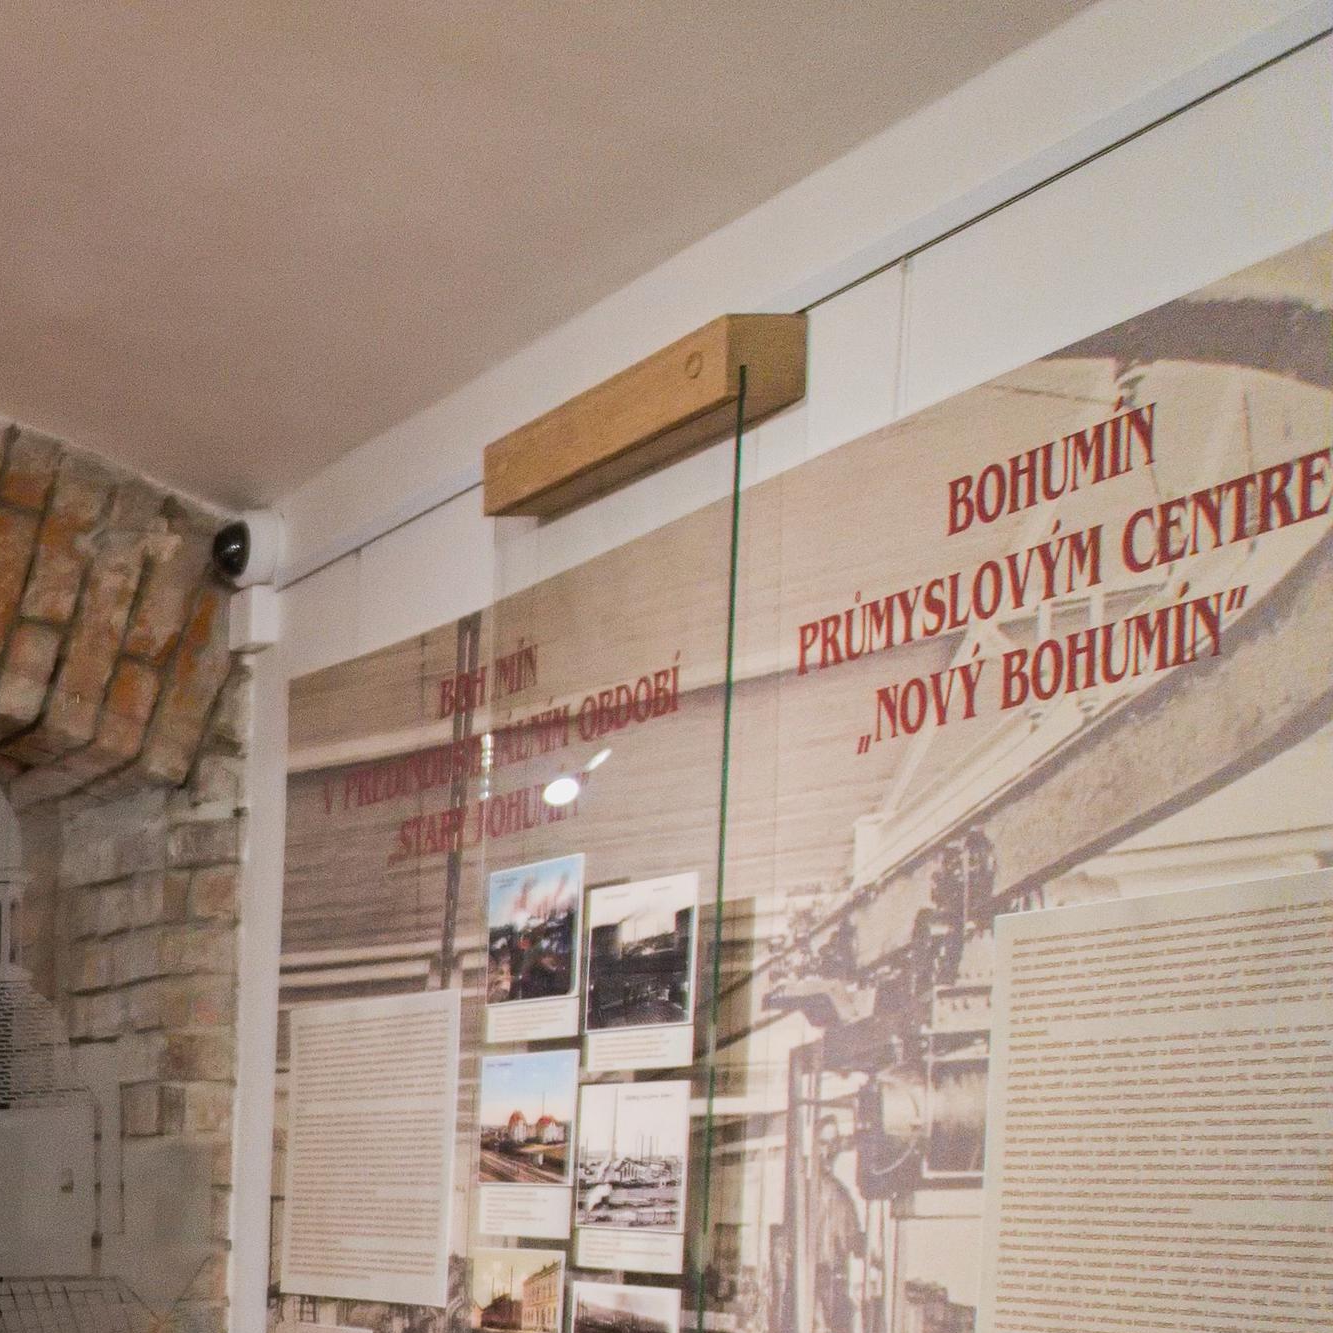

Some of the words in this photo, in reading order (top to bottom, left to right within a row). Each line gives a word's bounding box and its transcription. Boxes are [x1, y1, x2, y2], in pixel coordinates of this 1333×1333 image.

[945, 396, 1157, 537] BOHUMÍN
[796, 518, 1102, 677] PRŮMYSLOVÝM
[577, 650, 681, 743] OBDOBÍ
